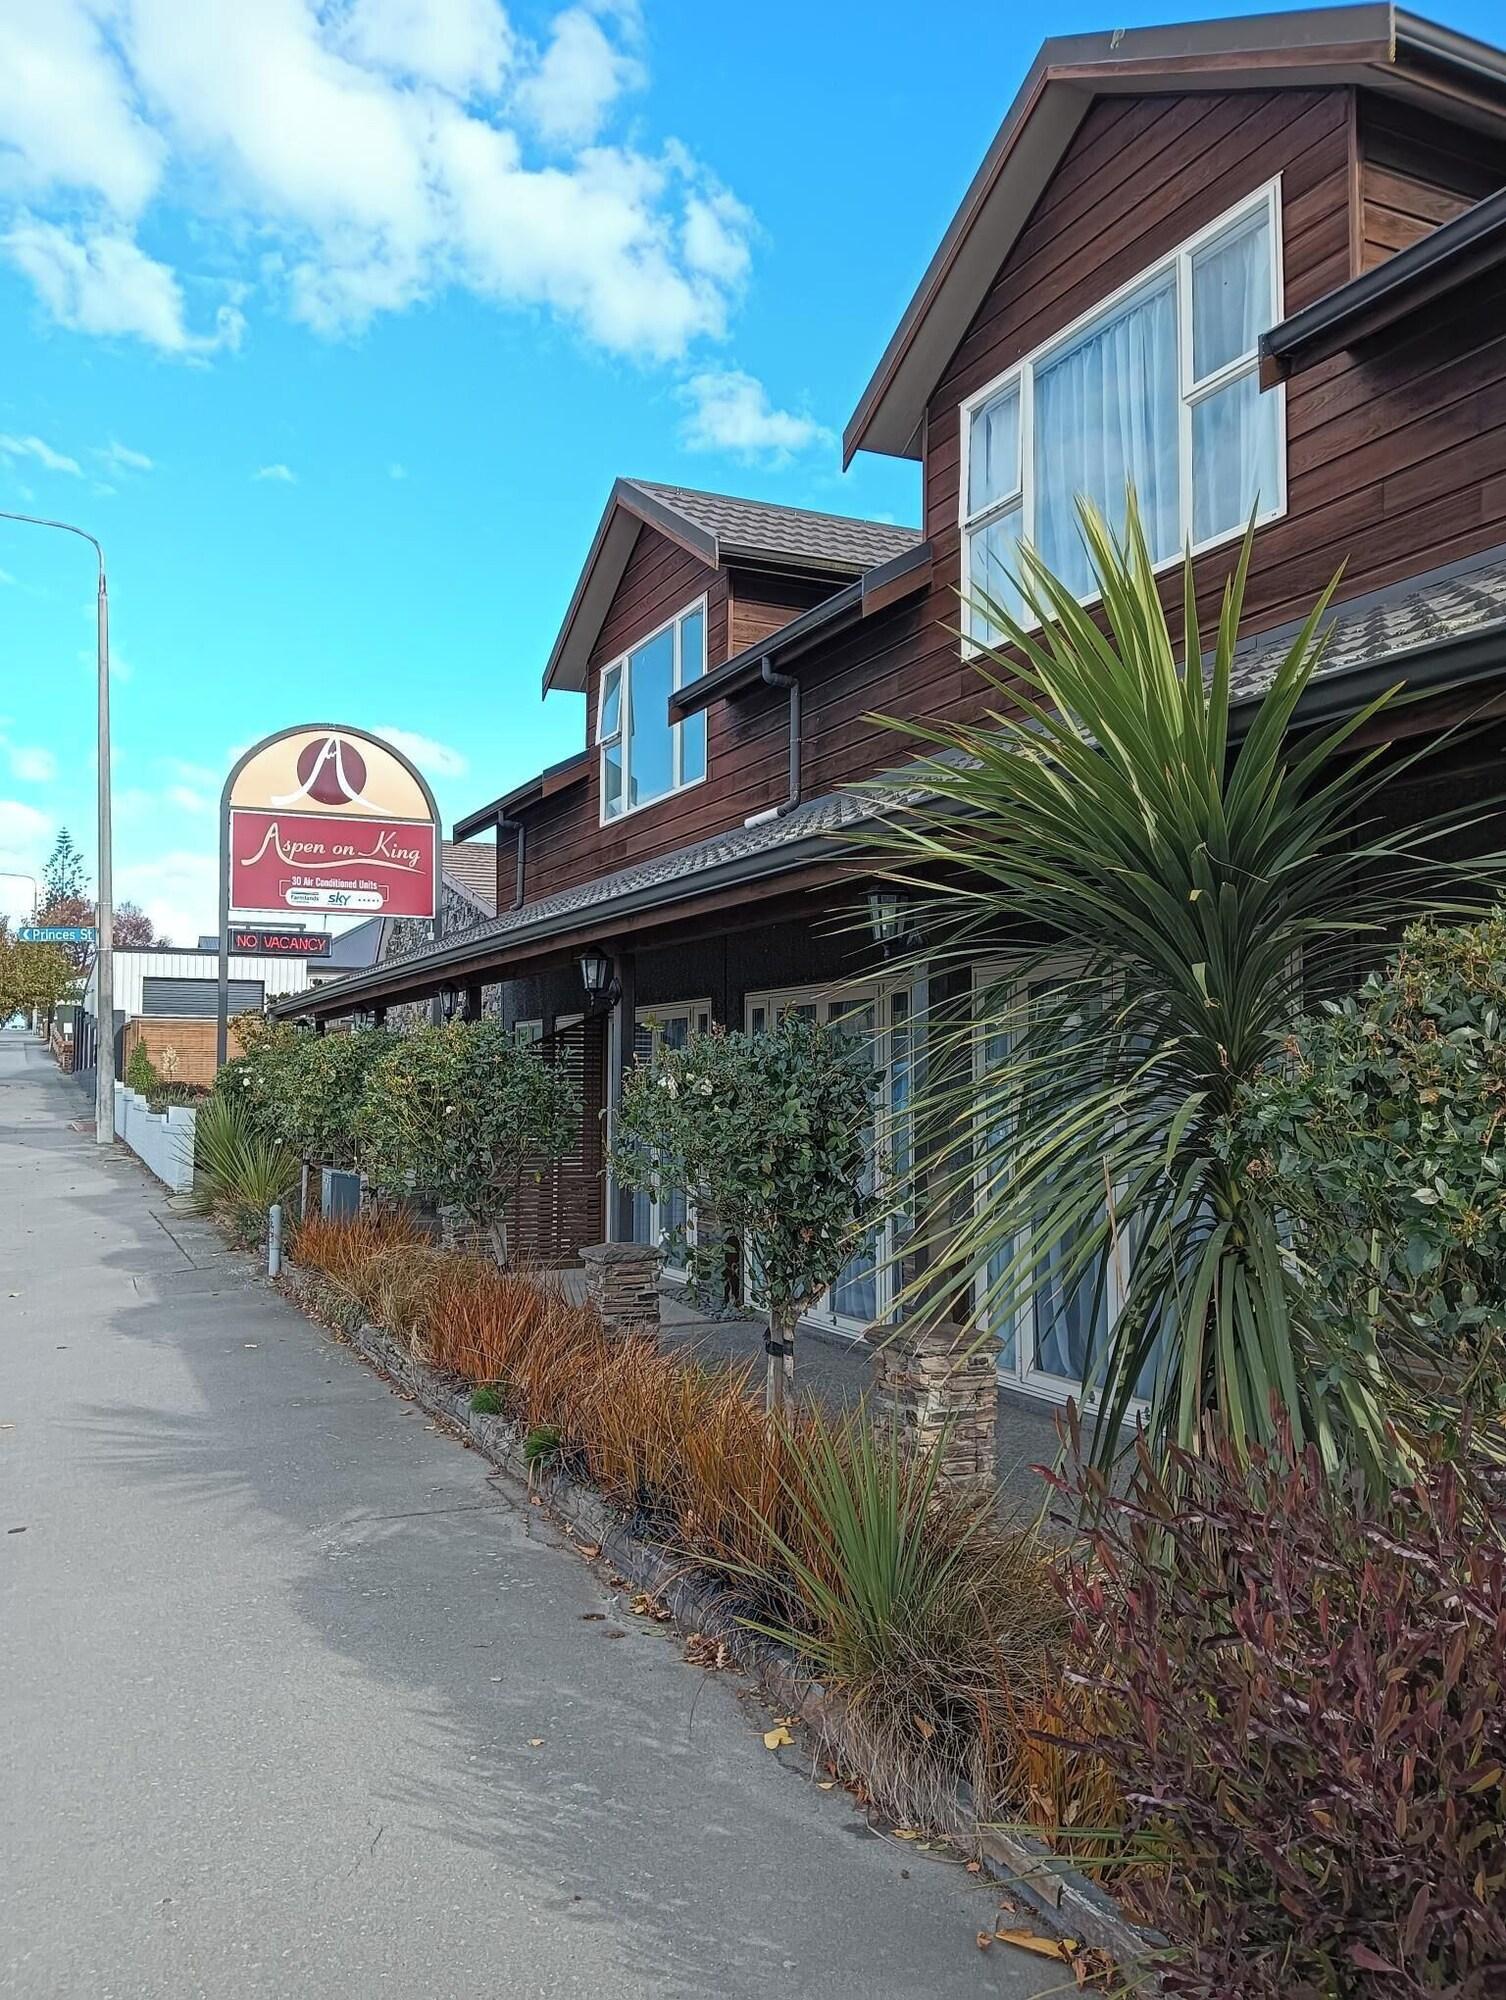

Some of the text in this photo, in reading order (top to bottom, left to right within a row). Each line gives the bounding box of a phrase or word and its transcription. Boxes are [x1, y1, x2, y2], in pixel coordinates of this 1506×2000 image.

[241, 822, 421, 868] Aspen on King
[291, 876, 378, 890] 30 Air Conditioned Units
[32, 928, 93, 940] Princes St
[237, 935, 326, 951] NO VACANCY
